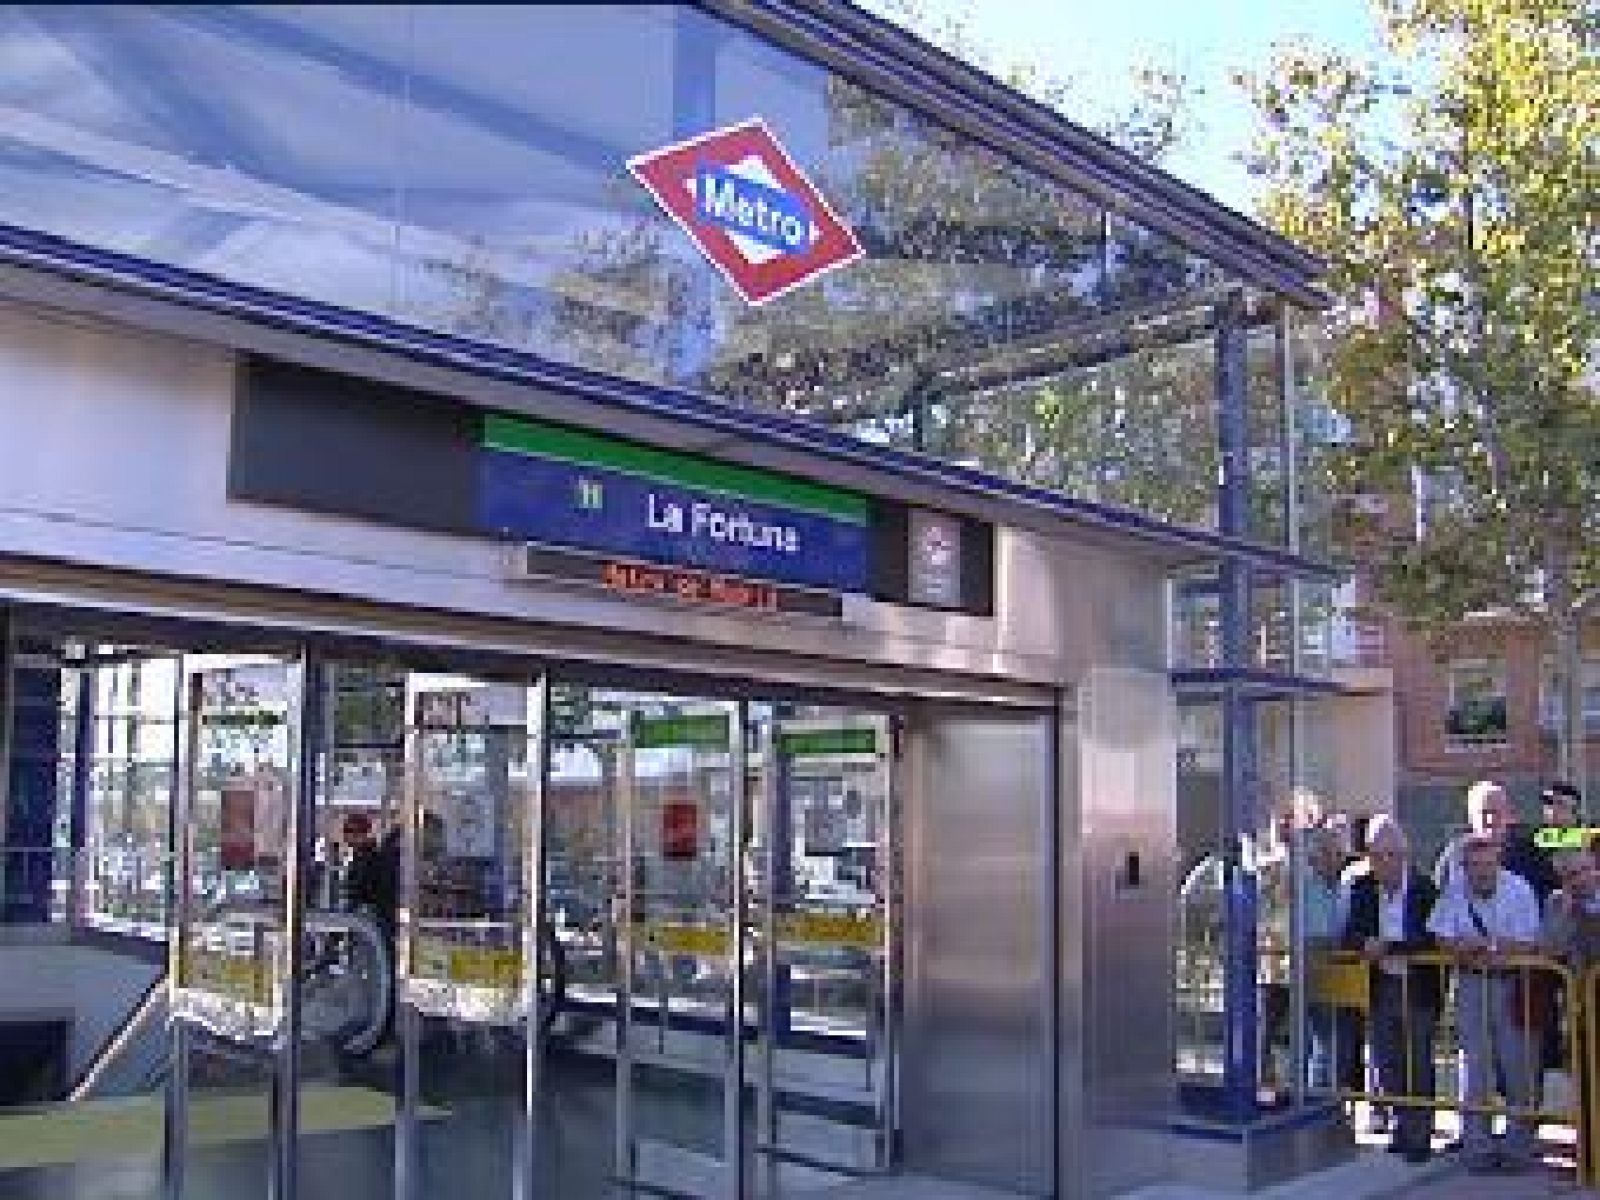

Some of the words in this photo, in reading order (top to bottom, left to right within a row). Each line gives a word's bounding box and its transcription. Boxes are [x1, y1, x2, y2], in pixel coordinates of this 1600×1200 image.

[704, 174, 803, 245] Metro
[648, 493, 682, 533] La
[691, 503, 798, 551] Fortuna
